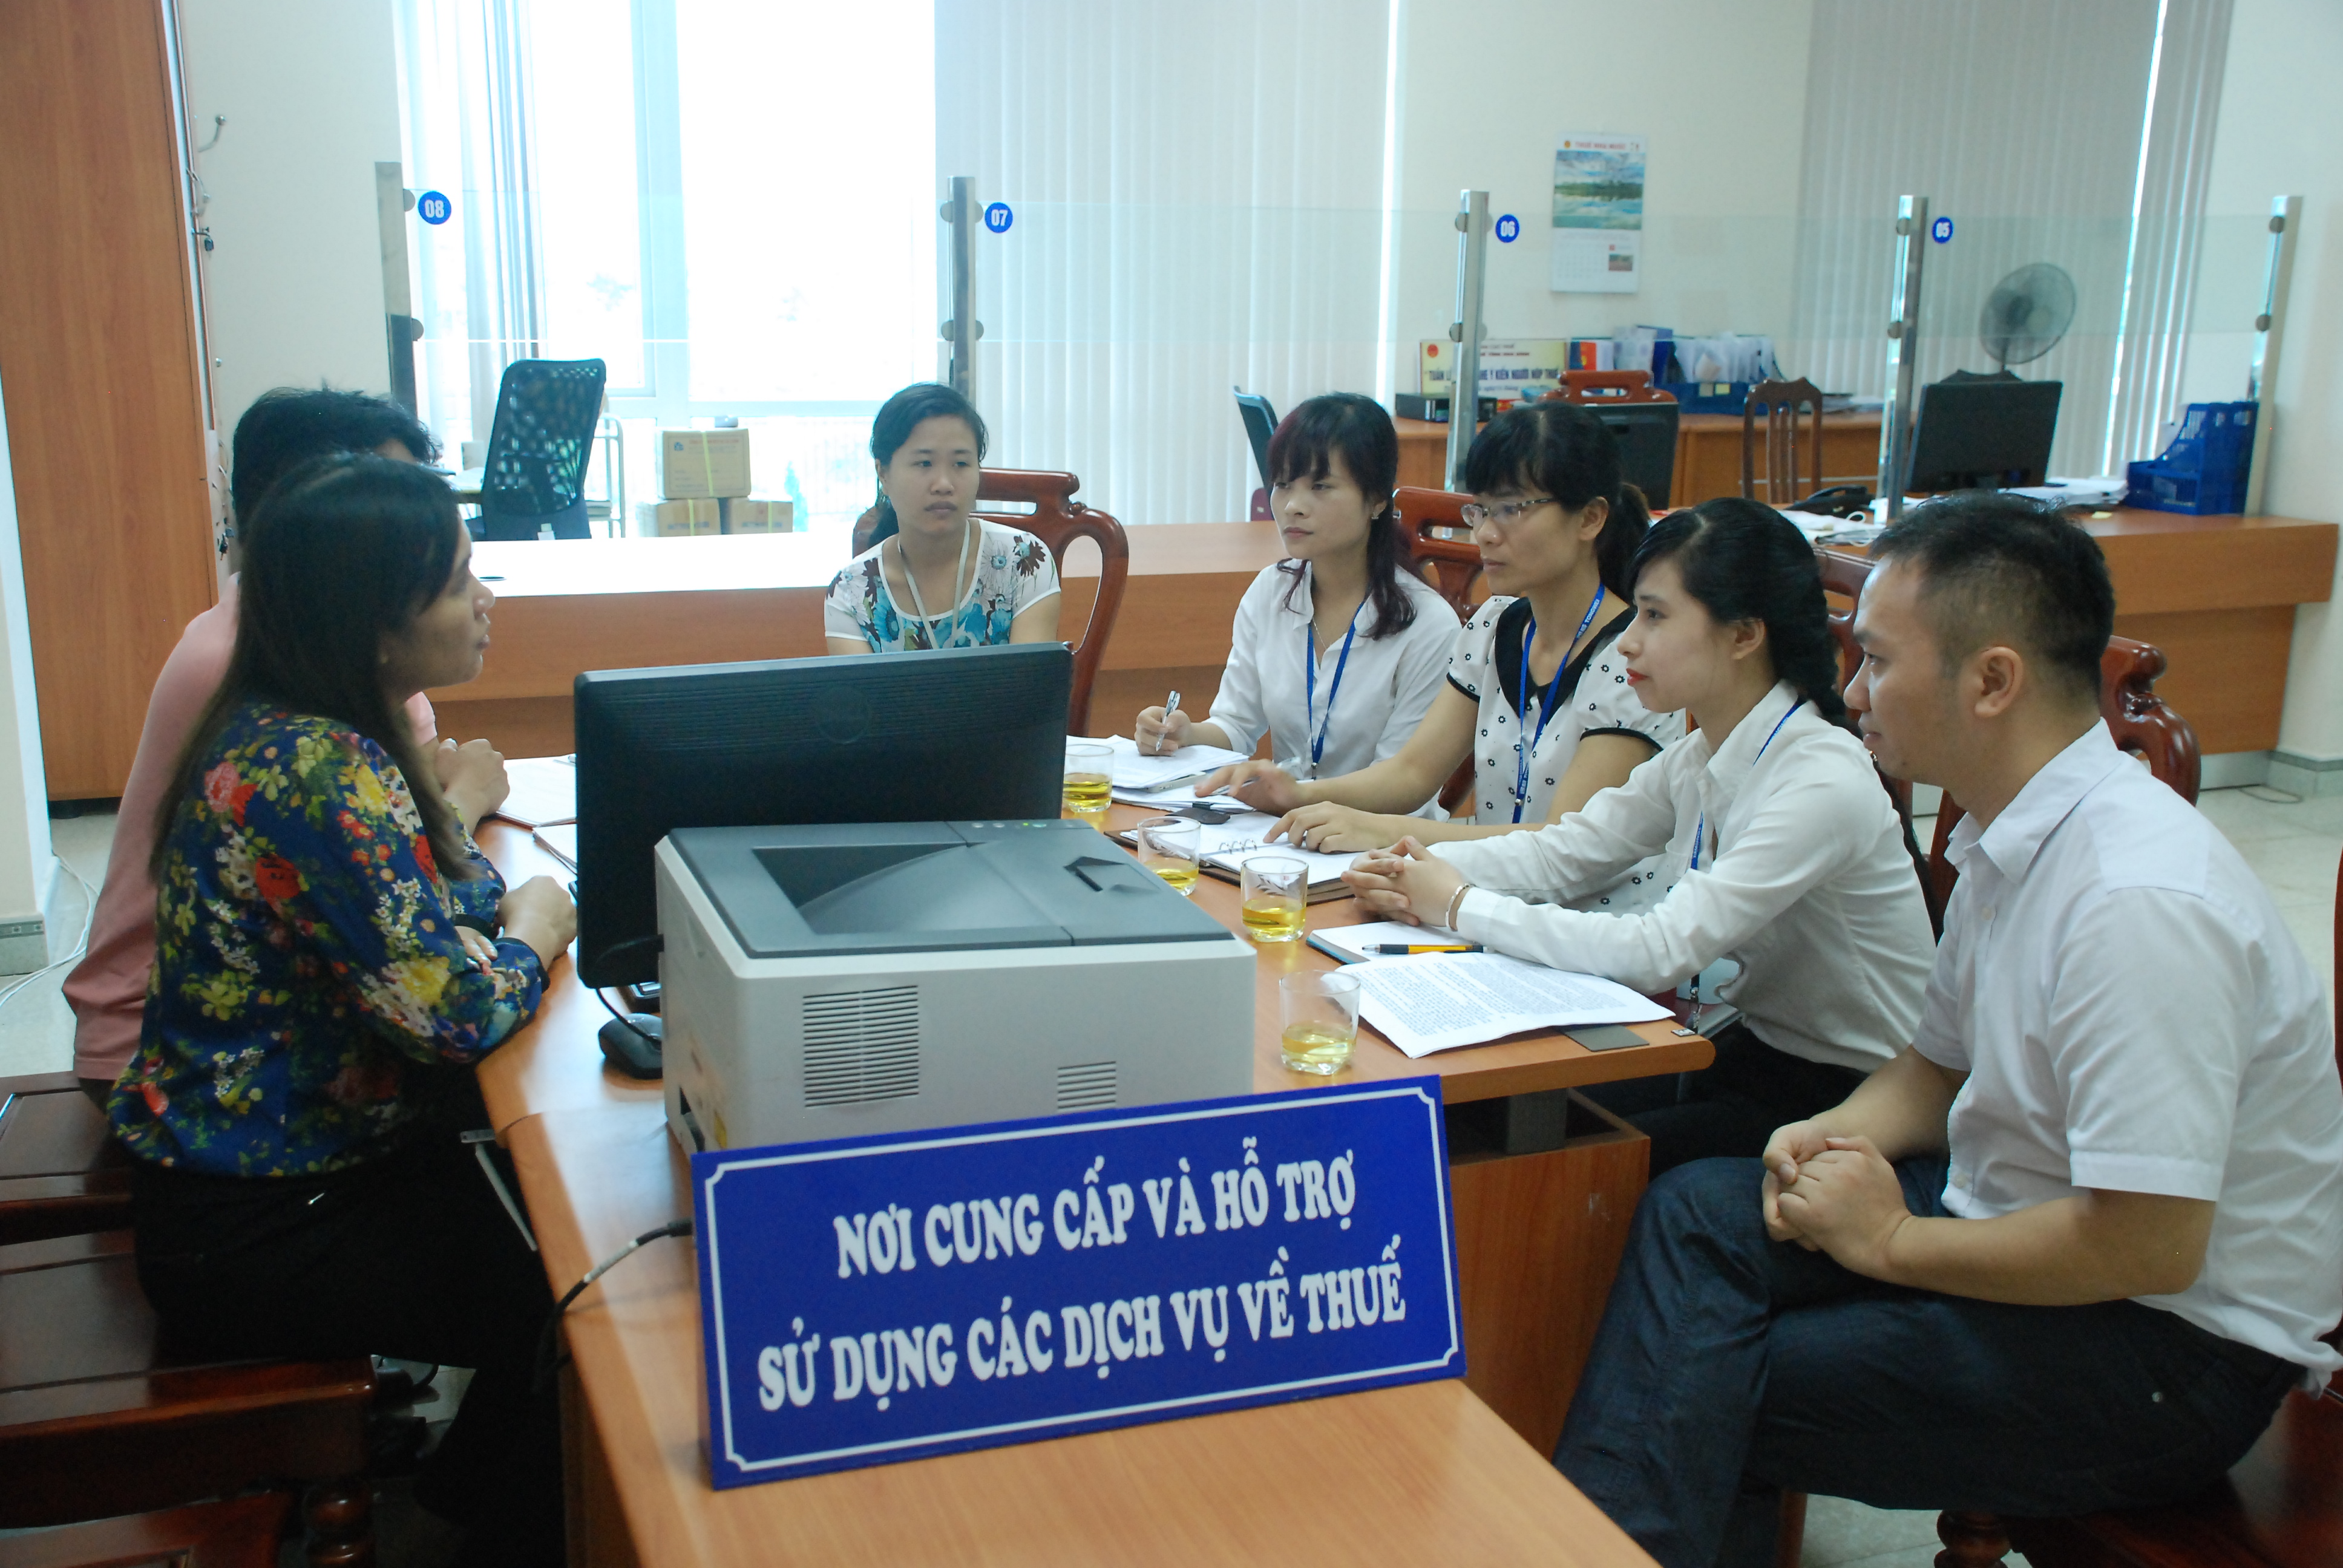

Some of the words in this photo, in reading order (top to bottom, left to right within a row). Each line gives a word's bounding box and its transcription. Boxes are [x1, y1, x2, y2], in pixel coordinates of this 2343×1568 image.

[425, 199, 445, 218] 08
[991, 209, 1008, 226] 07
[1501, 221, 1515, 237] 06
[1936, 222, 1950, 238] 05
[833, 1203, 916, 1278] NƠI
[925, 1189, 1046, 1267] CUNG
[1053, 1155, 1134, 1250] CẤP
[1142, 1157, 1207, 1238] VÀ
[1211, 1136, 1269, 1231] HỖ
[1276, 1148, 1355, 1230] TRỢ
[758, 1318, 820, 1411] SỬ
[830, 1318, 957, 1411] DỤNG
[966, 1296, 1053, 1380] CÁC
[1061, 1294, 1164, 1379] DỊCH
[1170, 1287, 1228, 1362] VỤ
[1237, 1246, 1294, 1341] VỀ
[1300, 1234, 1406, 1333] THUẾ
